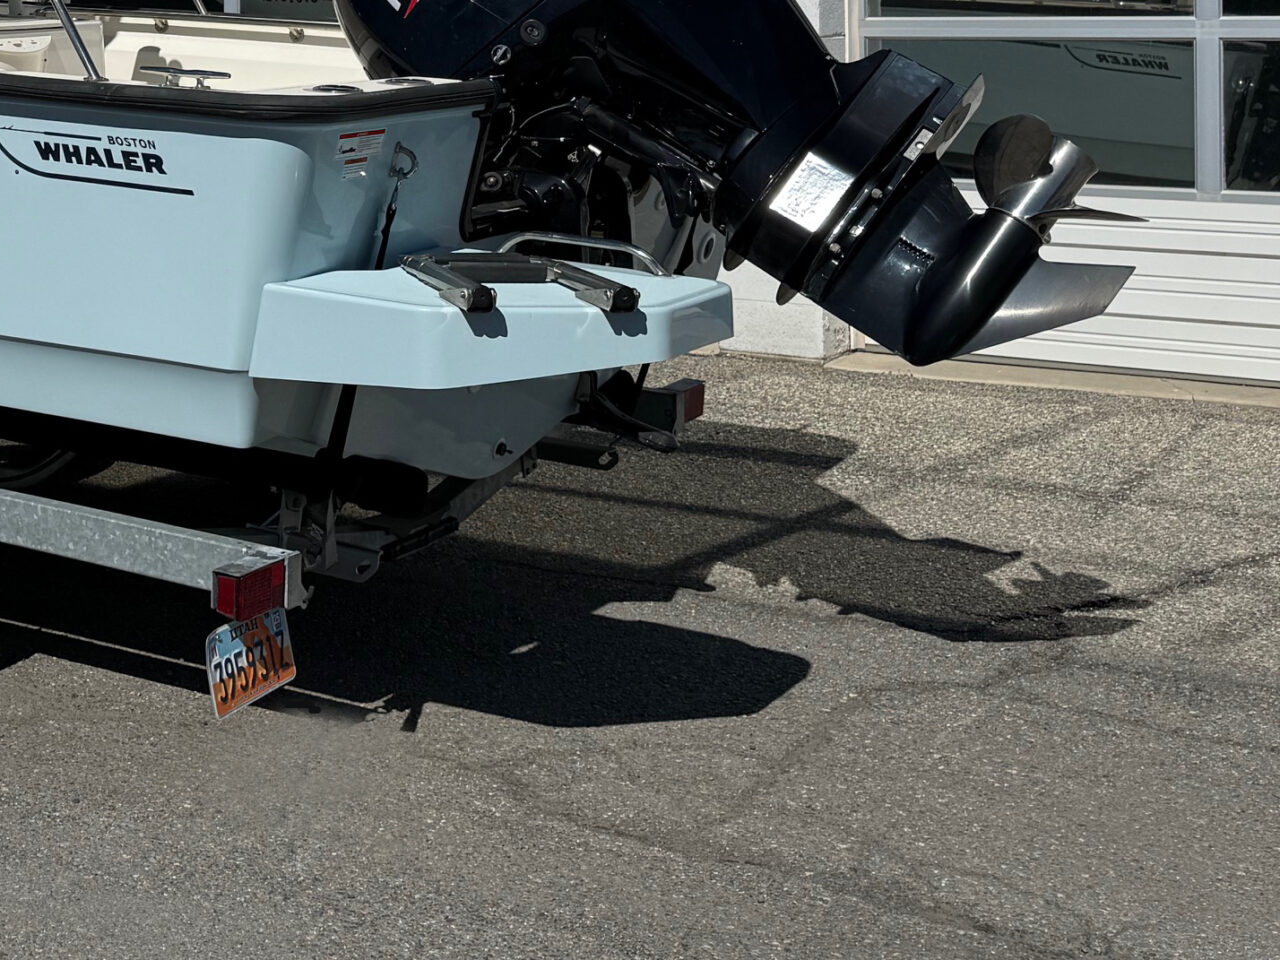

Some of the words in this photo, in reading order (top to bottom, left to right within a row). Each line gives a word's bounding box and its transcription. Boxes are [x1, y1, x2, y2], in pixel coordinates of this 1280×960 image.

[107, 135, 156, 150] BOSTON
[34, 140, 167, 175] WHALER
[229, 618, 258, 642] UTAH
